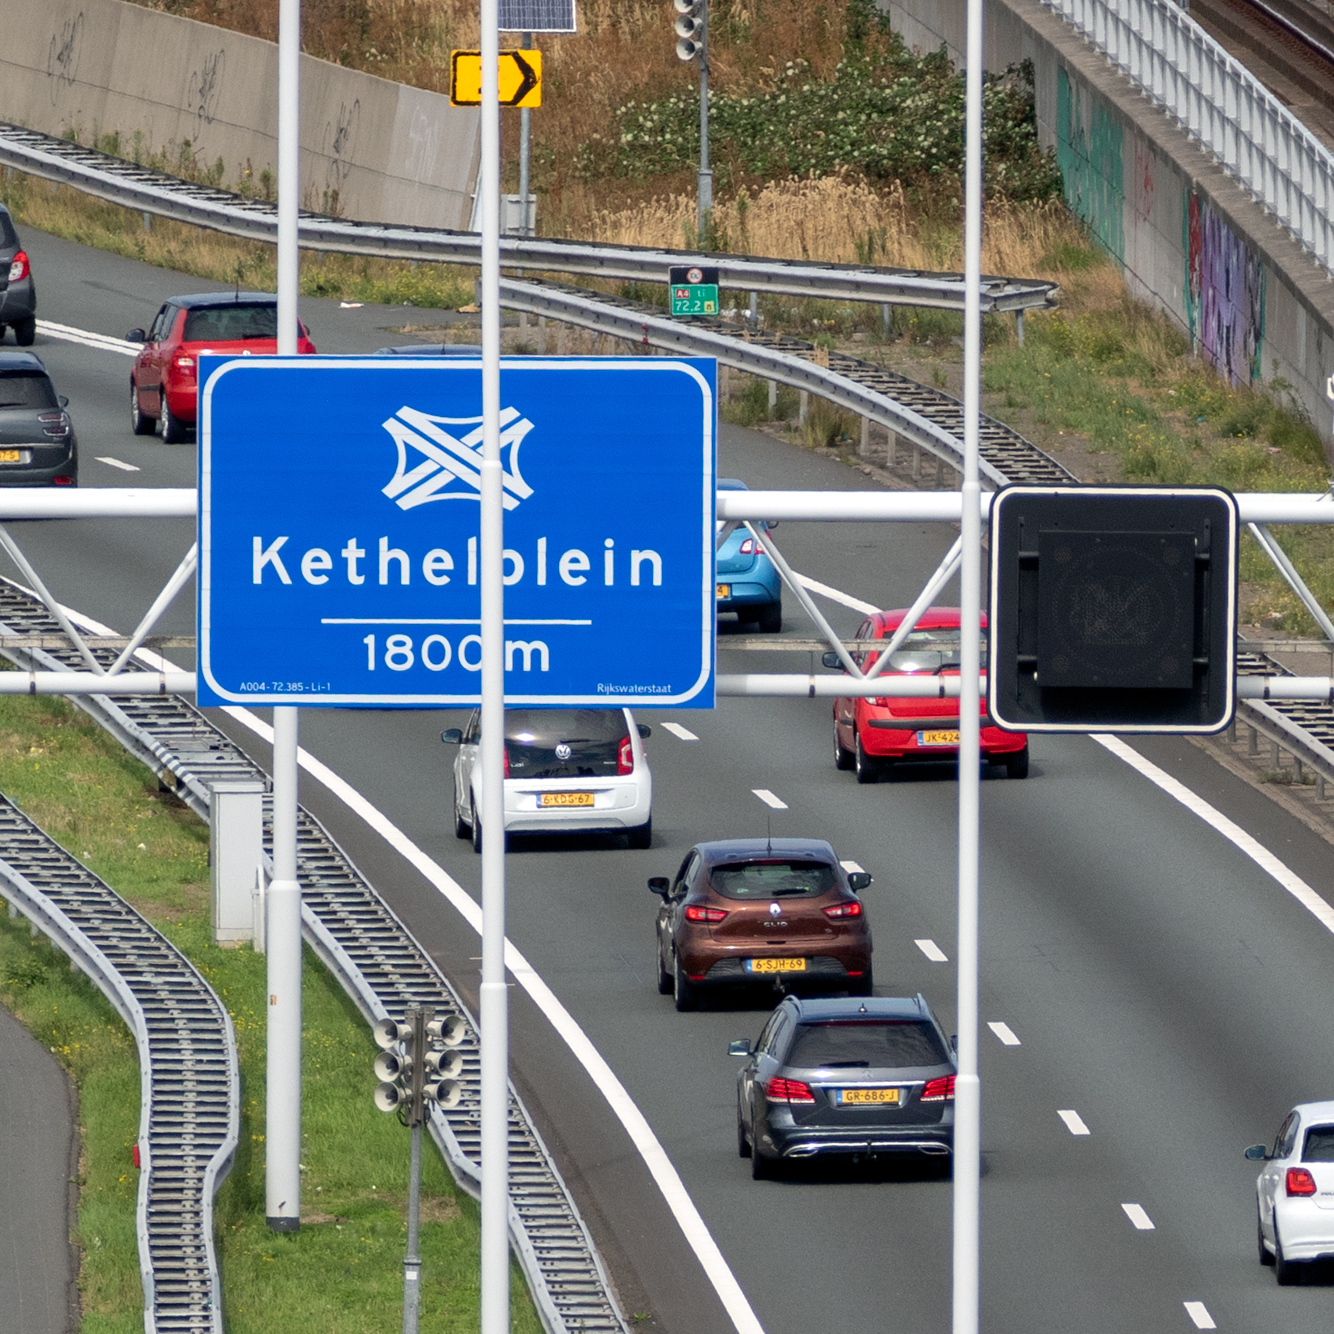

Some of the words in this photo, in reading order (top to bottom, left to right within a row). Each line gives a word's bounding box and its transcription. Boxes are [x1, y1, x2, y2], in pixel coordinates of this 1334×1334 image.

[363, 633, 481, 672] 1800
[504, 640, 550, 672] m
[597, 683, 672, 695] Rijkswaterstaat
[756, 959, 803, 970] 6-SJH-69
[846, 1090, 895, 1102] GR-686-J
